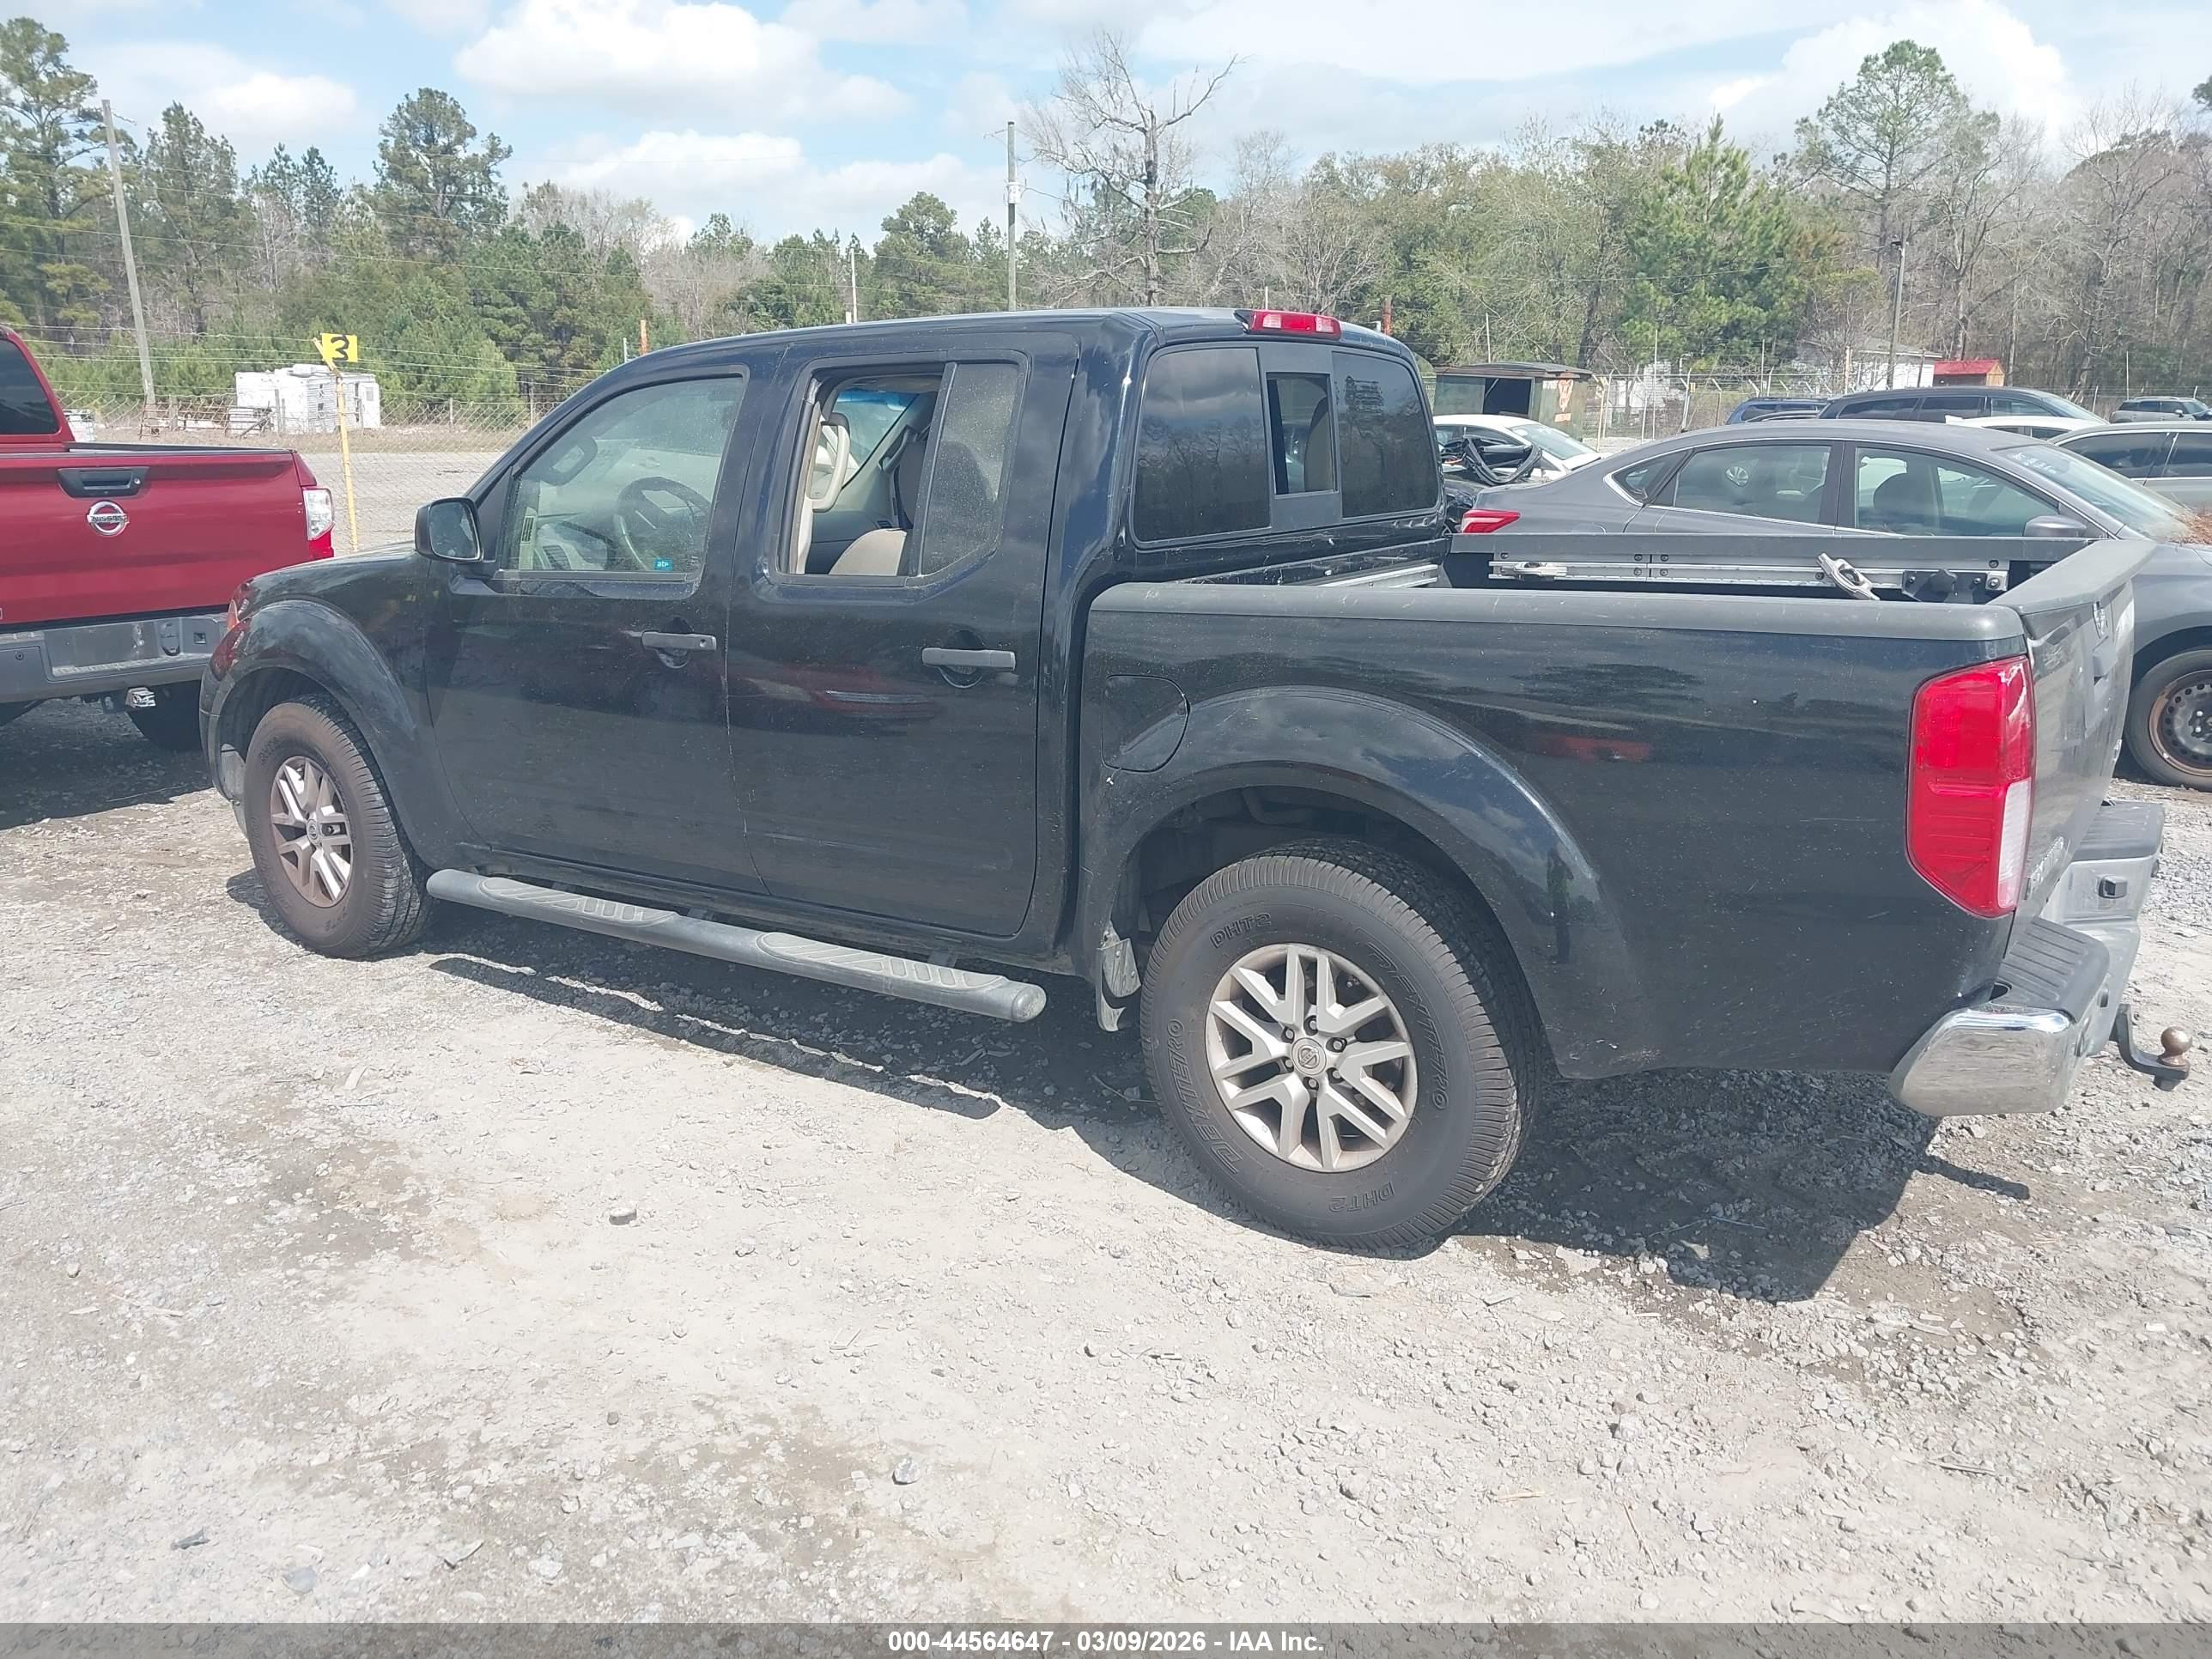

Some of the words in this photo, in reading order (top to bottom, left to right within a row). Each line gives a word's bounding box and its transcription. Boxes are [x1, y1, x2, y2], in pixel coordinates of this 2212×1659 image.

[331, 335, 349, 362] 3
[1209, 912, 1272, 949] DHT2
[1167, 1018, 1243, 1175] DEXTERO
[1328, 1181, 1395, 1213] DHT2
